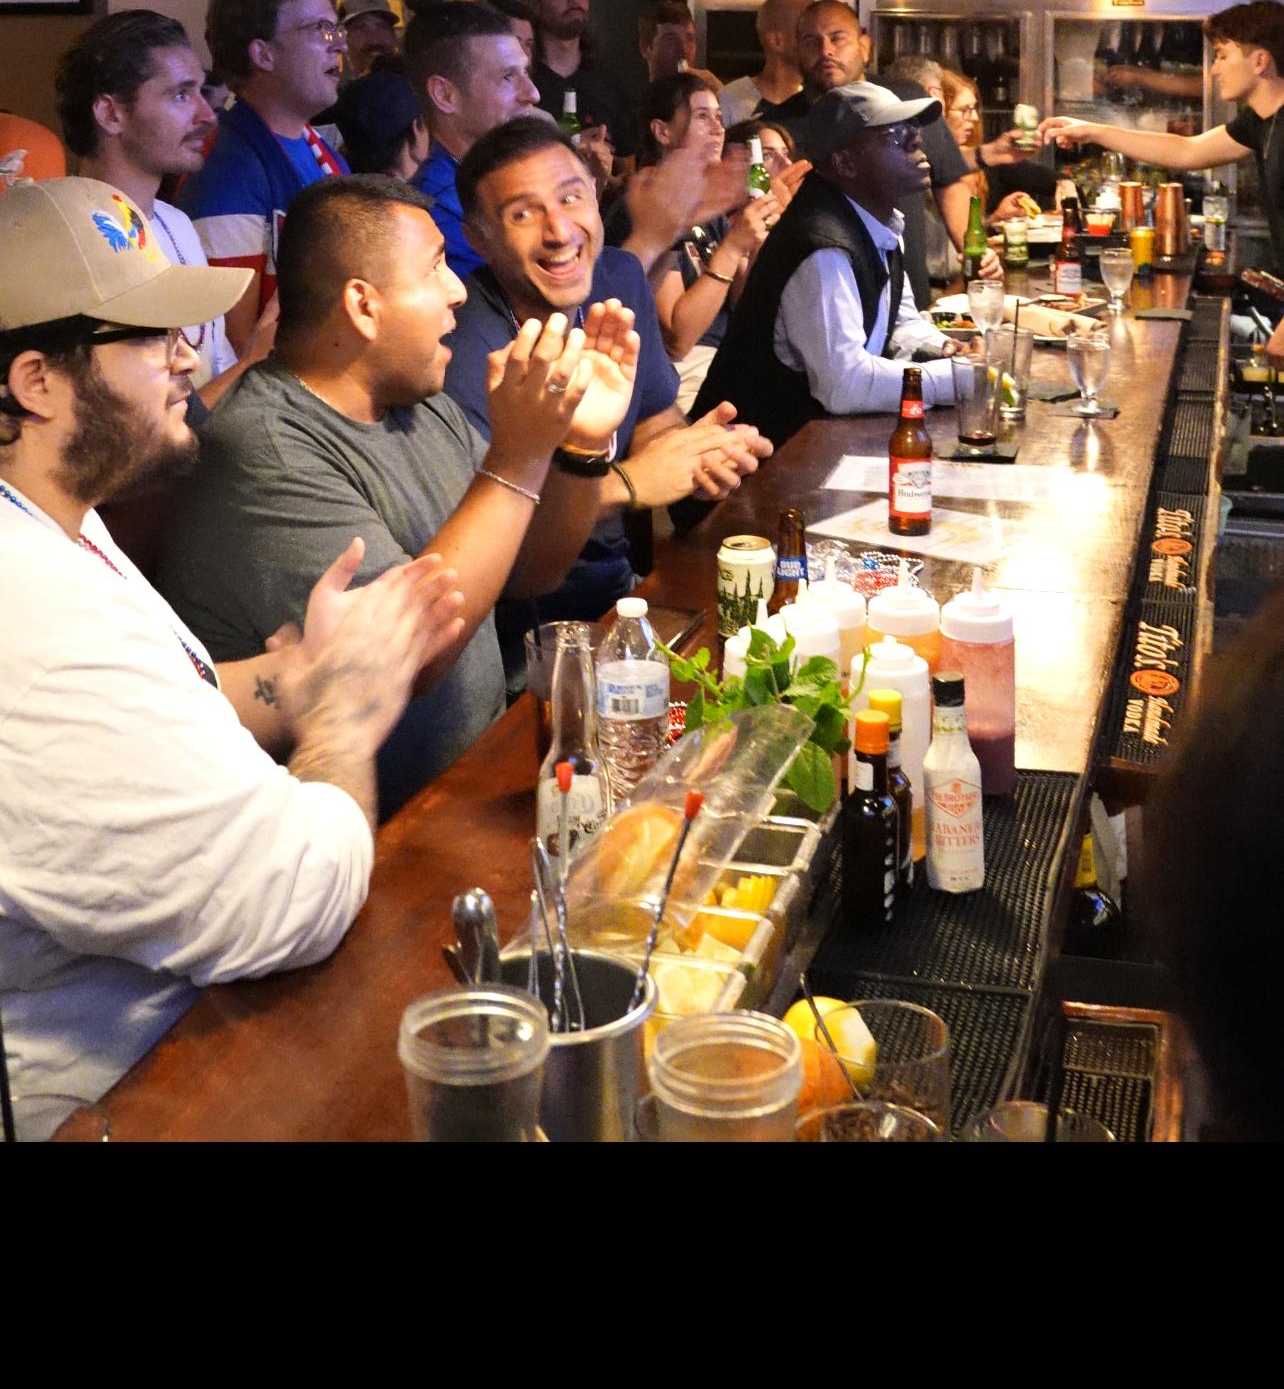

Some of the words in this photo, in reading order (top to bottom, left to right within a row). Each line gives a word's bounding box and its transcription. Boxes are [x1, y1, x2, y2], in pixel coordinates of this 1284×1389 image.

[777, 567, 805, 577] LIGHT
[779, 560, 801, 569] BUD
[1133, 621, 1184, 670] Tito's
[1123, 698, 1144, 732] VODKA
